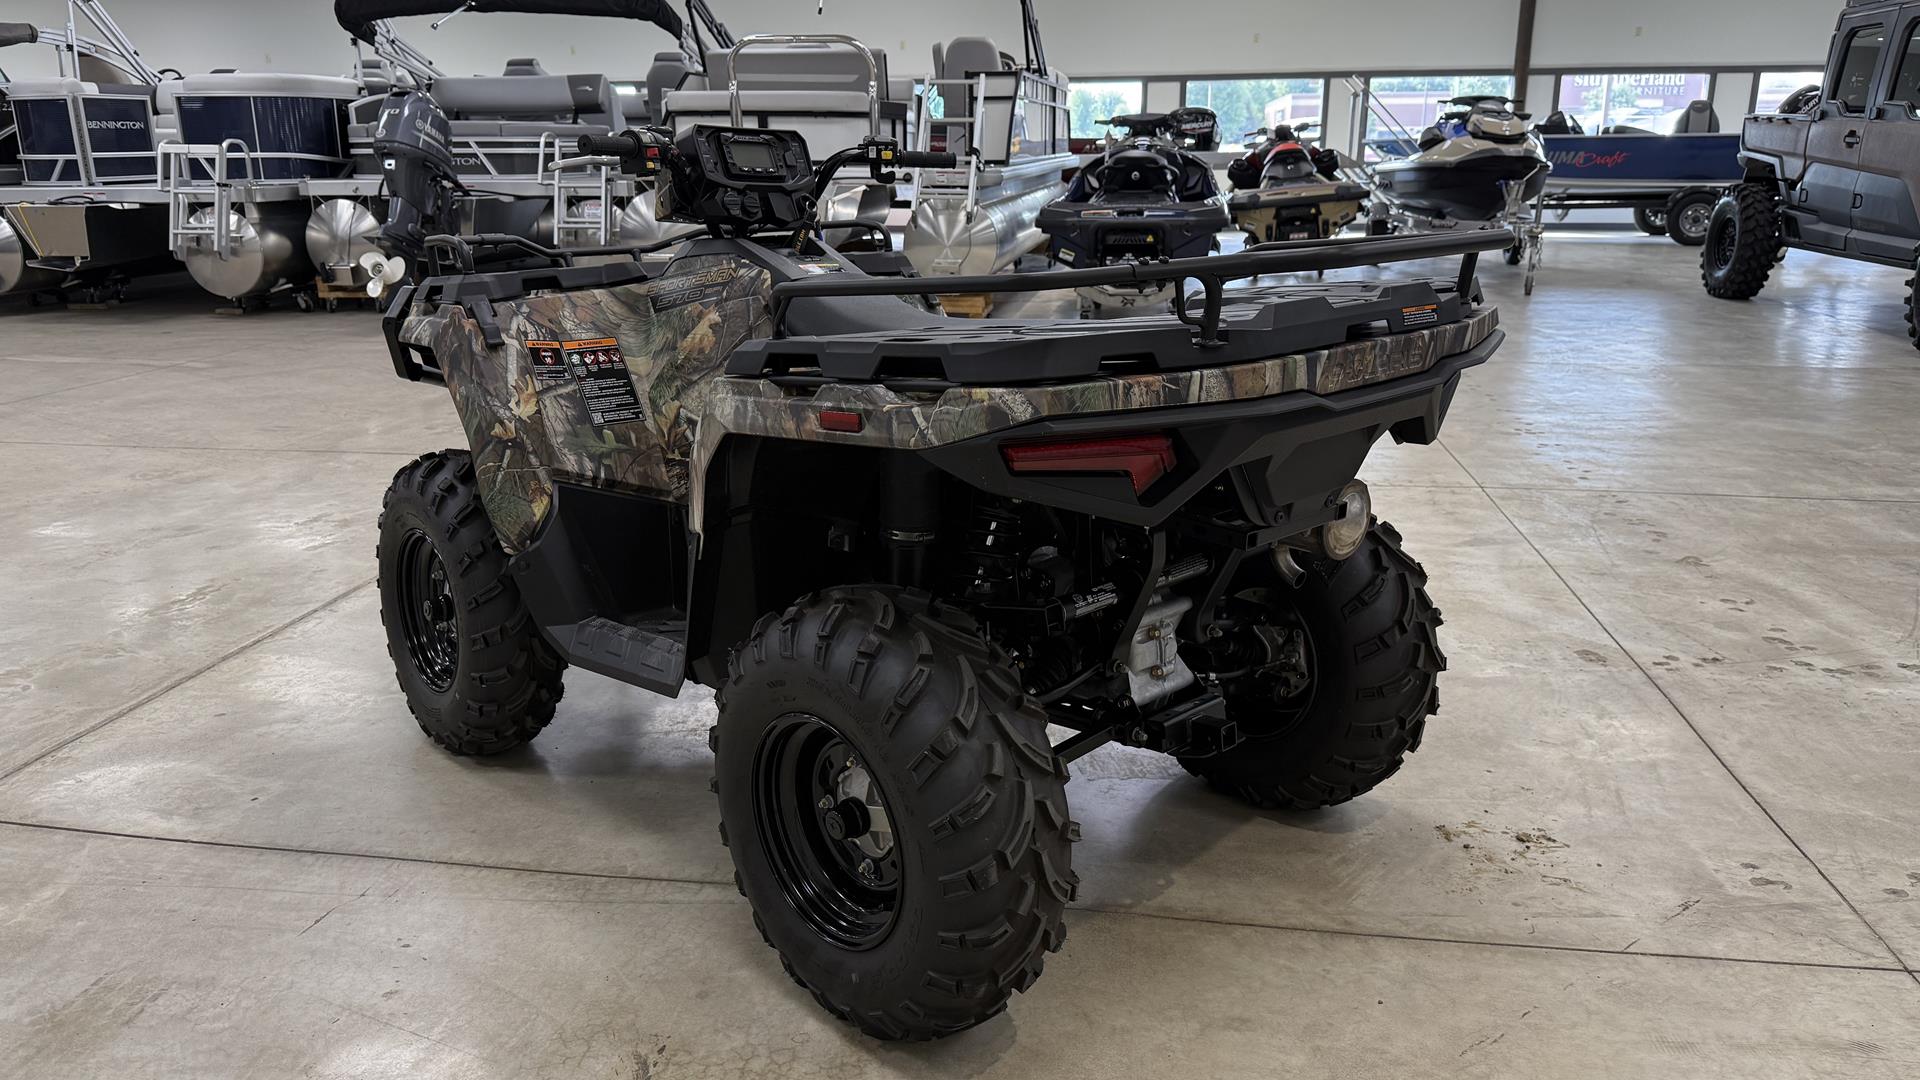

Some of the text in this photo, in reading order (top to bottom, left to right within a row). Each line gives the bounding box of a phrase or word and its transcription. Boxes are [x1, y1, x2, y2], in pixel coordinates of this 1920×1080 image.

[87, 120, 145, 129] BENNINGTON
[647, 266, 740, 296] SPORTSMAN
[656, 287, 705, 309] 570
